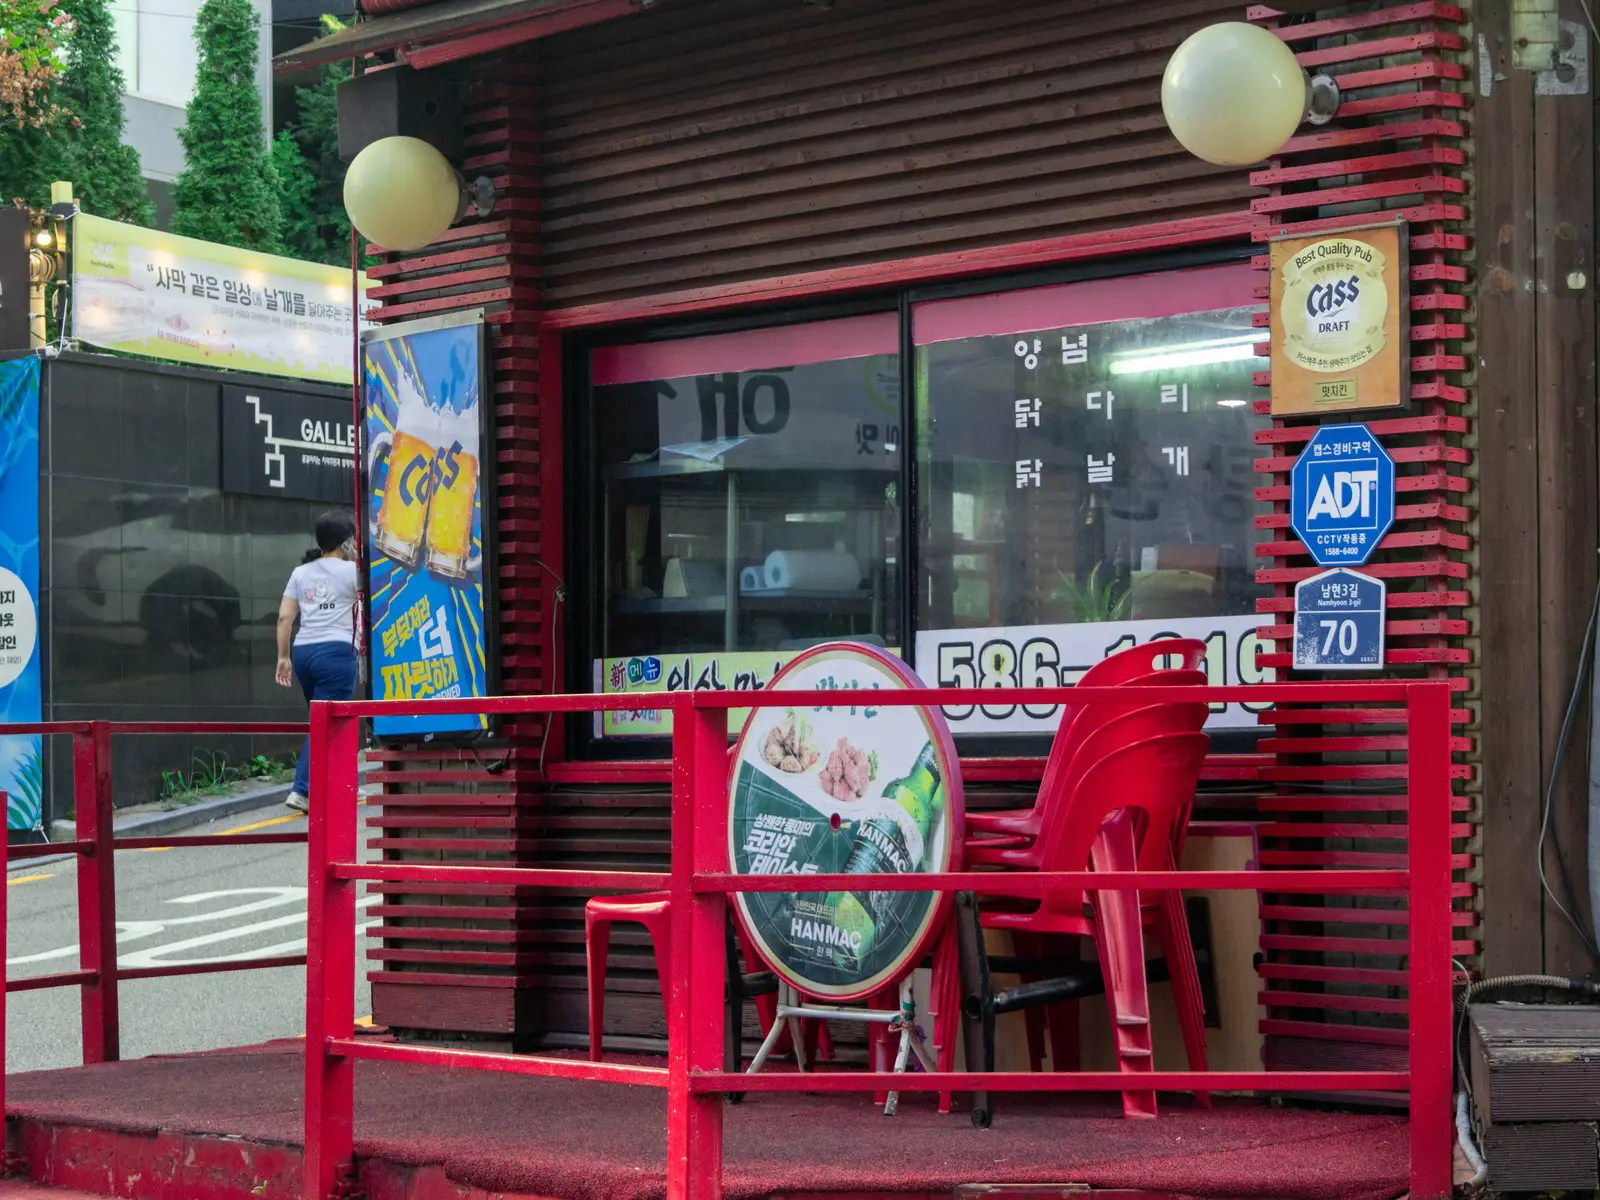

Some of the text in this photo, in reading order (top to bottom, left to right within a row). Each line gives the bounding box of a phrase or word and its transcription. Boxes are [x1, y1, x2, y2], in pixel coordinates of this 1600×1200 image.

[1295, 242, 1373, 269] Best Quality Pub
[189, 271, 220, 299] 같은
[264, 288, 305, 317] 날개를
[1306, 275, 1360, 318] Cass
[1318, 320, 1350, 333] DRAFT
[1321, 384, 1348, 398] 맛치킨
[301, 418, 362, 447] GALLE
[1313, 441, 1371, 457] 캡스경비구역
[1307, 470, 1378, 519] ADT
[1325, 547, 1359, 556] 1588-6400
[1318, 599, 1361, 607] Namhyeon 3-gil
[1321, 583, 1358, 599] 남현3길
[418, 605, 454, 660] 더
[1320, 619, 1358, 656] 70
[743, 829, 796, 858] 코리안
[790, 917, 862, 950] HANMAC
